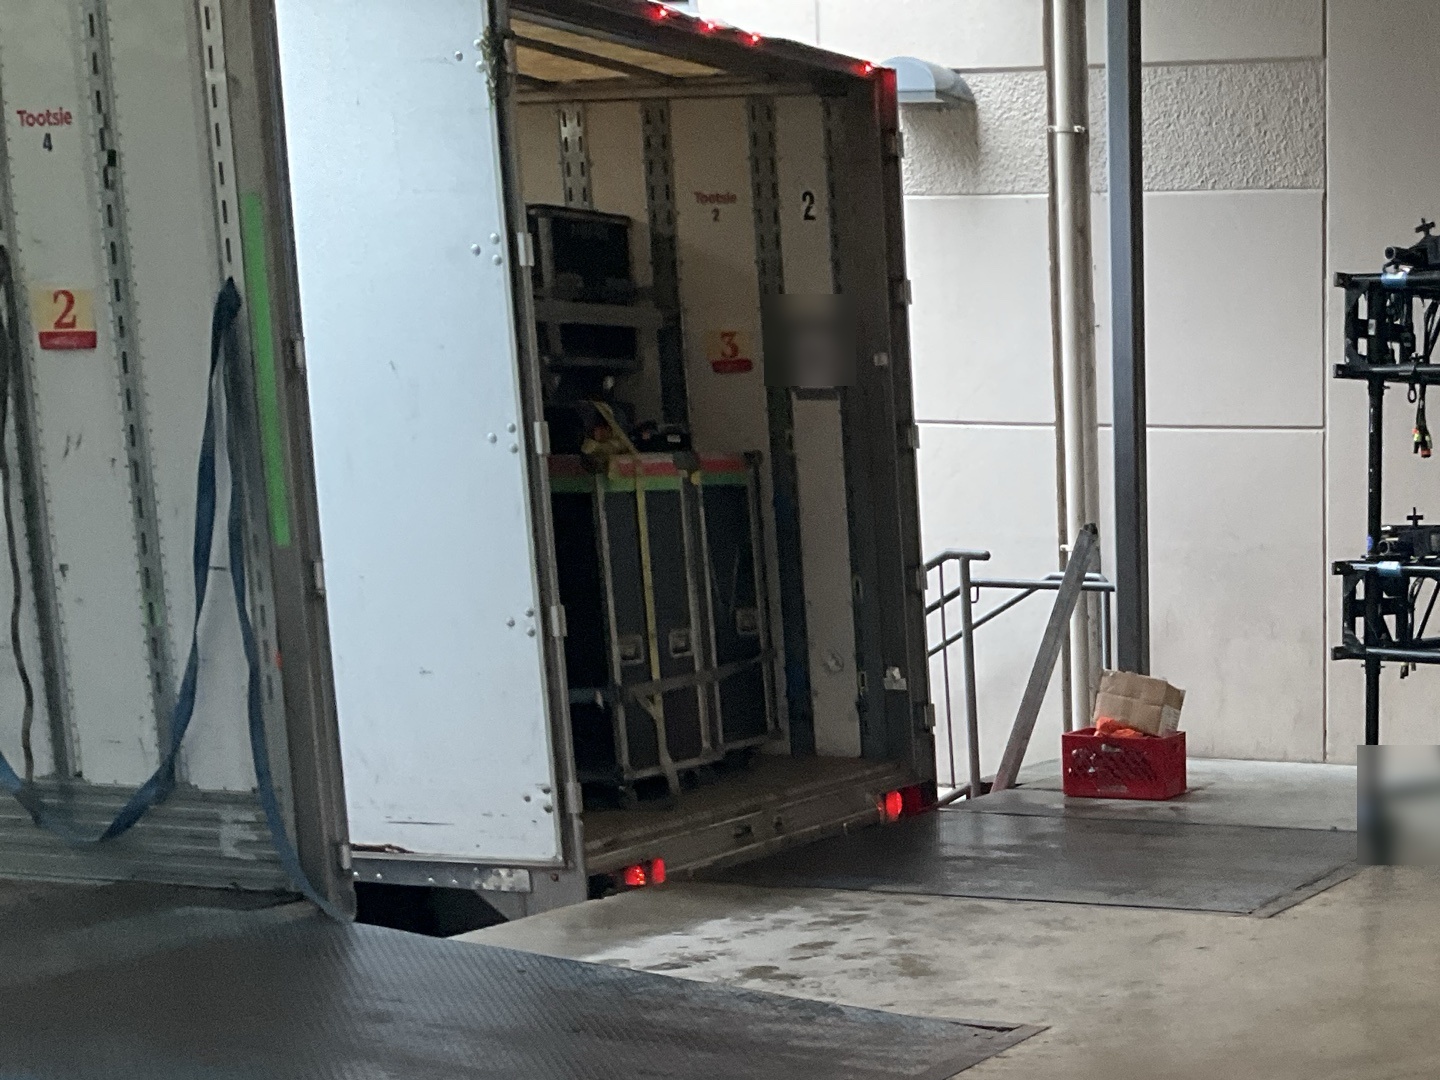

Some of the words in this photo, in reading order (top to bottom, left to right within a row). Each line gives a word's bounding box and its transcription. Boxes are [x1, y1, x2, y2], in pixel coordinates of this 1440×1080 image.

[16, 107, 73, 127] Tootsie
[43, 132, 53, 152] 4
[712, 208, 720, 222] 2
[802, 190, 816, 221] 2
[52, 289, 77, 330] 2
[720, 331, 739, 359] 3
